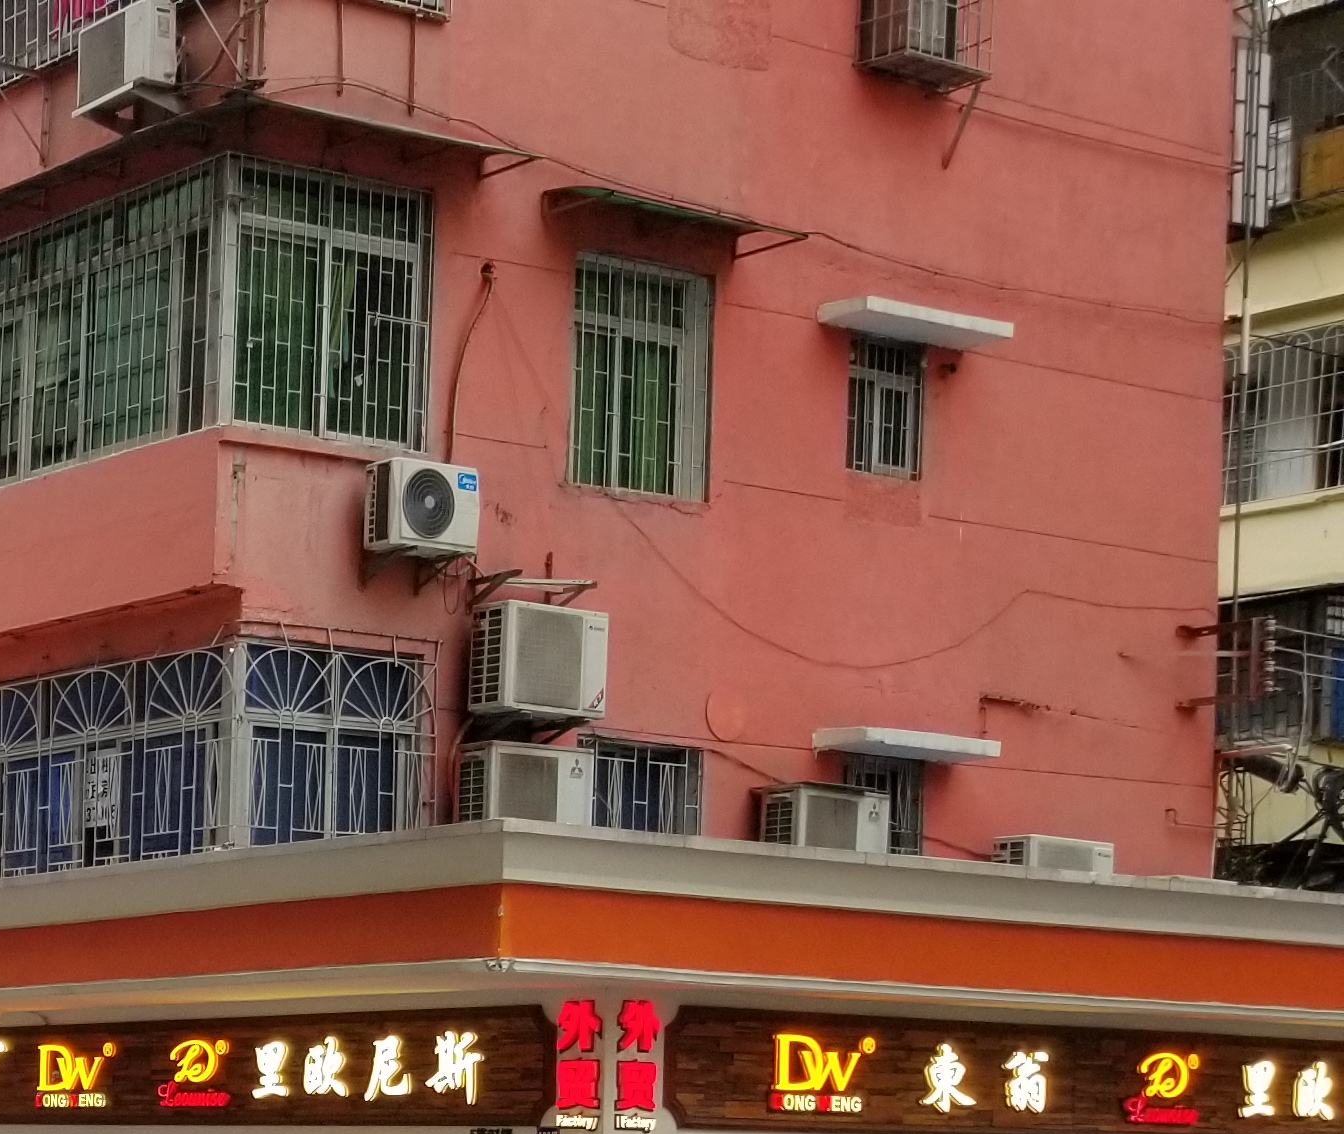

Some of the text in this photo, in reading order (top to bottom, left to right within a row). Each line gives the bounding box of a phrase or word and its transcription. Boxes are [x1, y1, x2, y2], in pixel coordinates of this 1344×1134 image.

[251, 1030, 485, 1106] 里欧尼斯
[555, 1000, 602, 1111] 外贸
[614, 1000, 662, 1111] 外贸
[918, 1042, 1050, 1114] 東翁
[1237, 1060, 1335, 1121] 里欧
[555, 1114, 599, 1131] Factory
